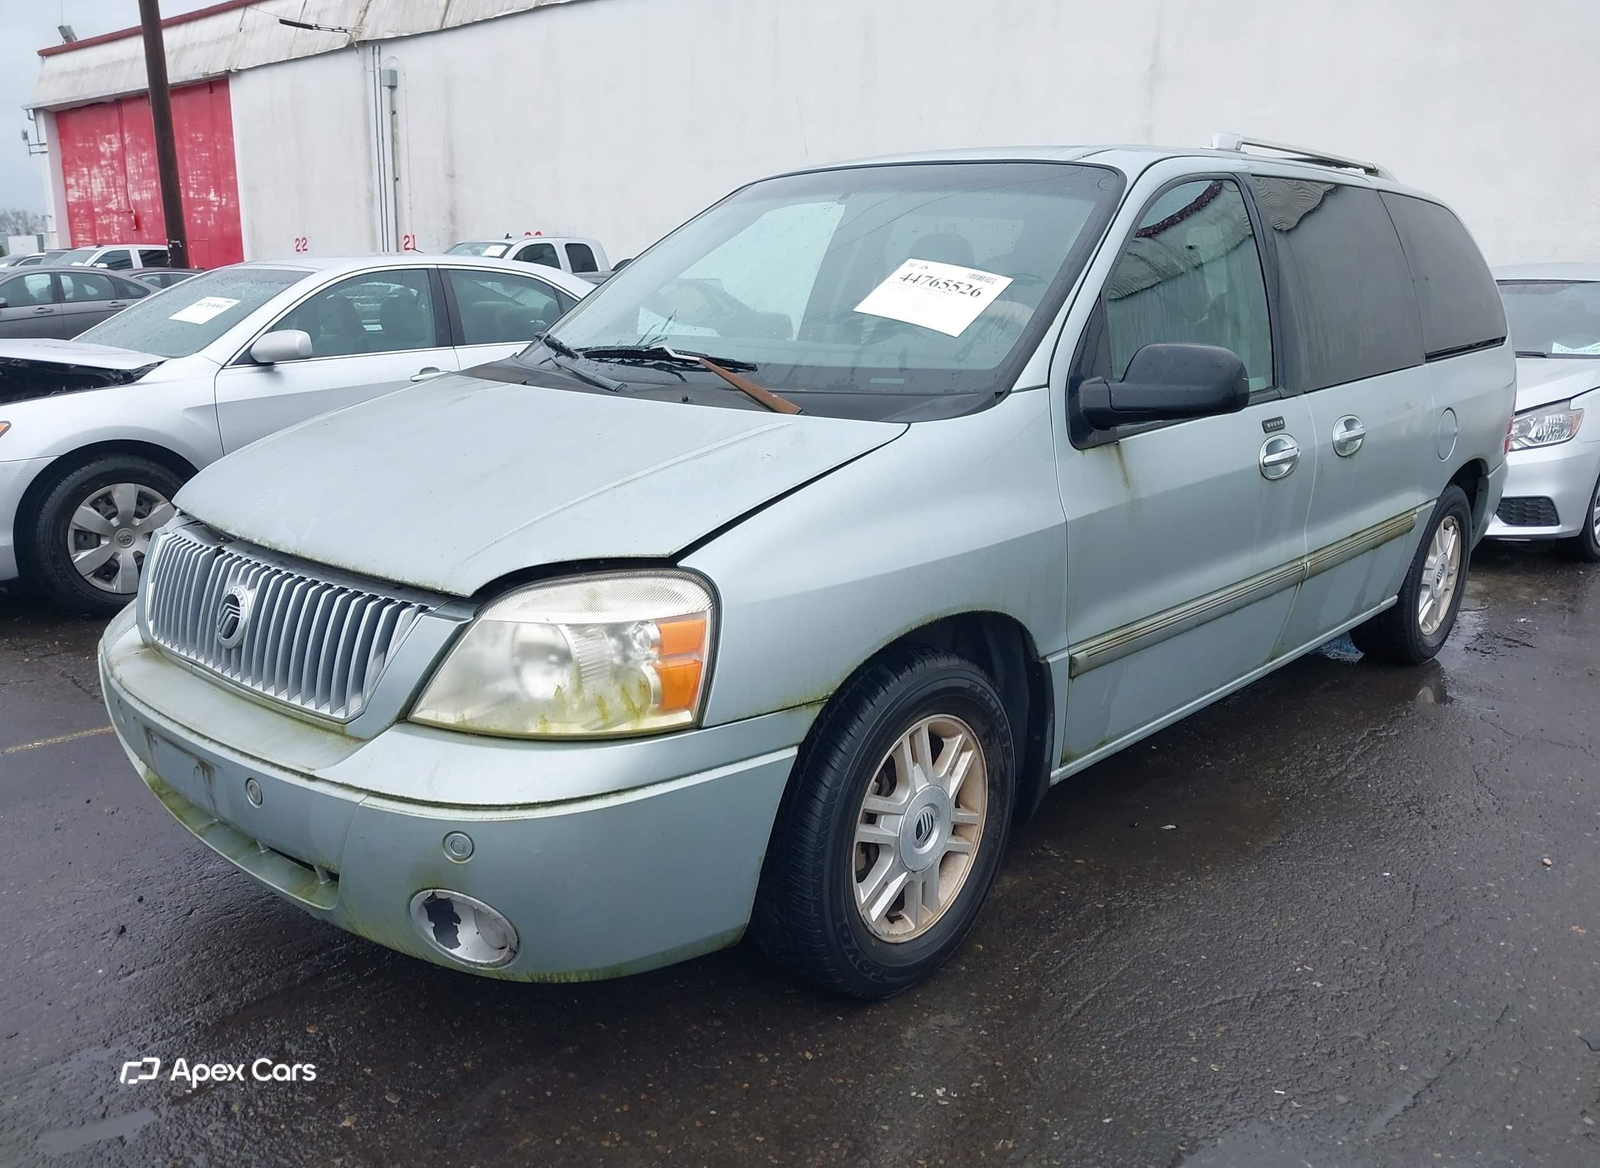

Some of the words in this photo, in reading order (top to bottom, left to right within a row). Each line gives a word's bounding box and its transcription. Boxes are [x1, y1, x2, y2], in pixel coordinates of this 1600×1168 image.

[294, 237, 308, 252] 22
[403, 234, 416, 251] 21
[899, 272, 982, 298] 44765526
